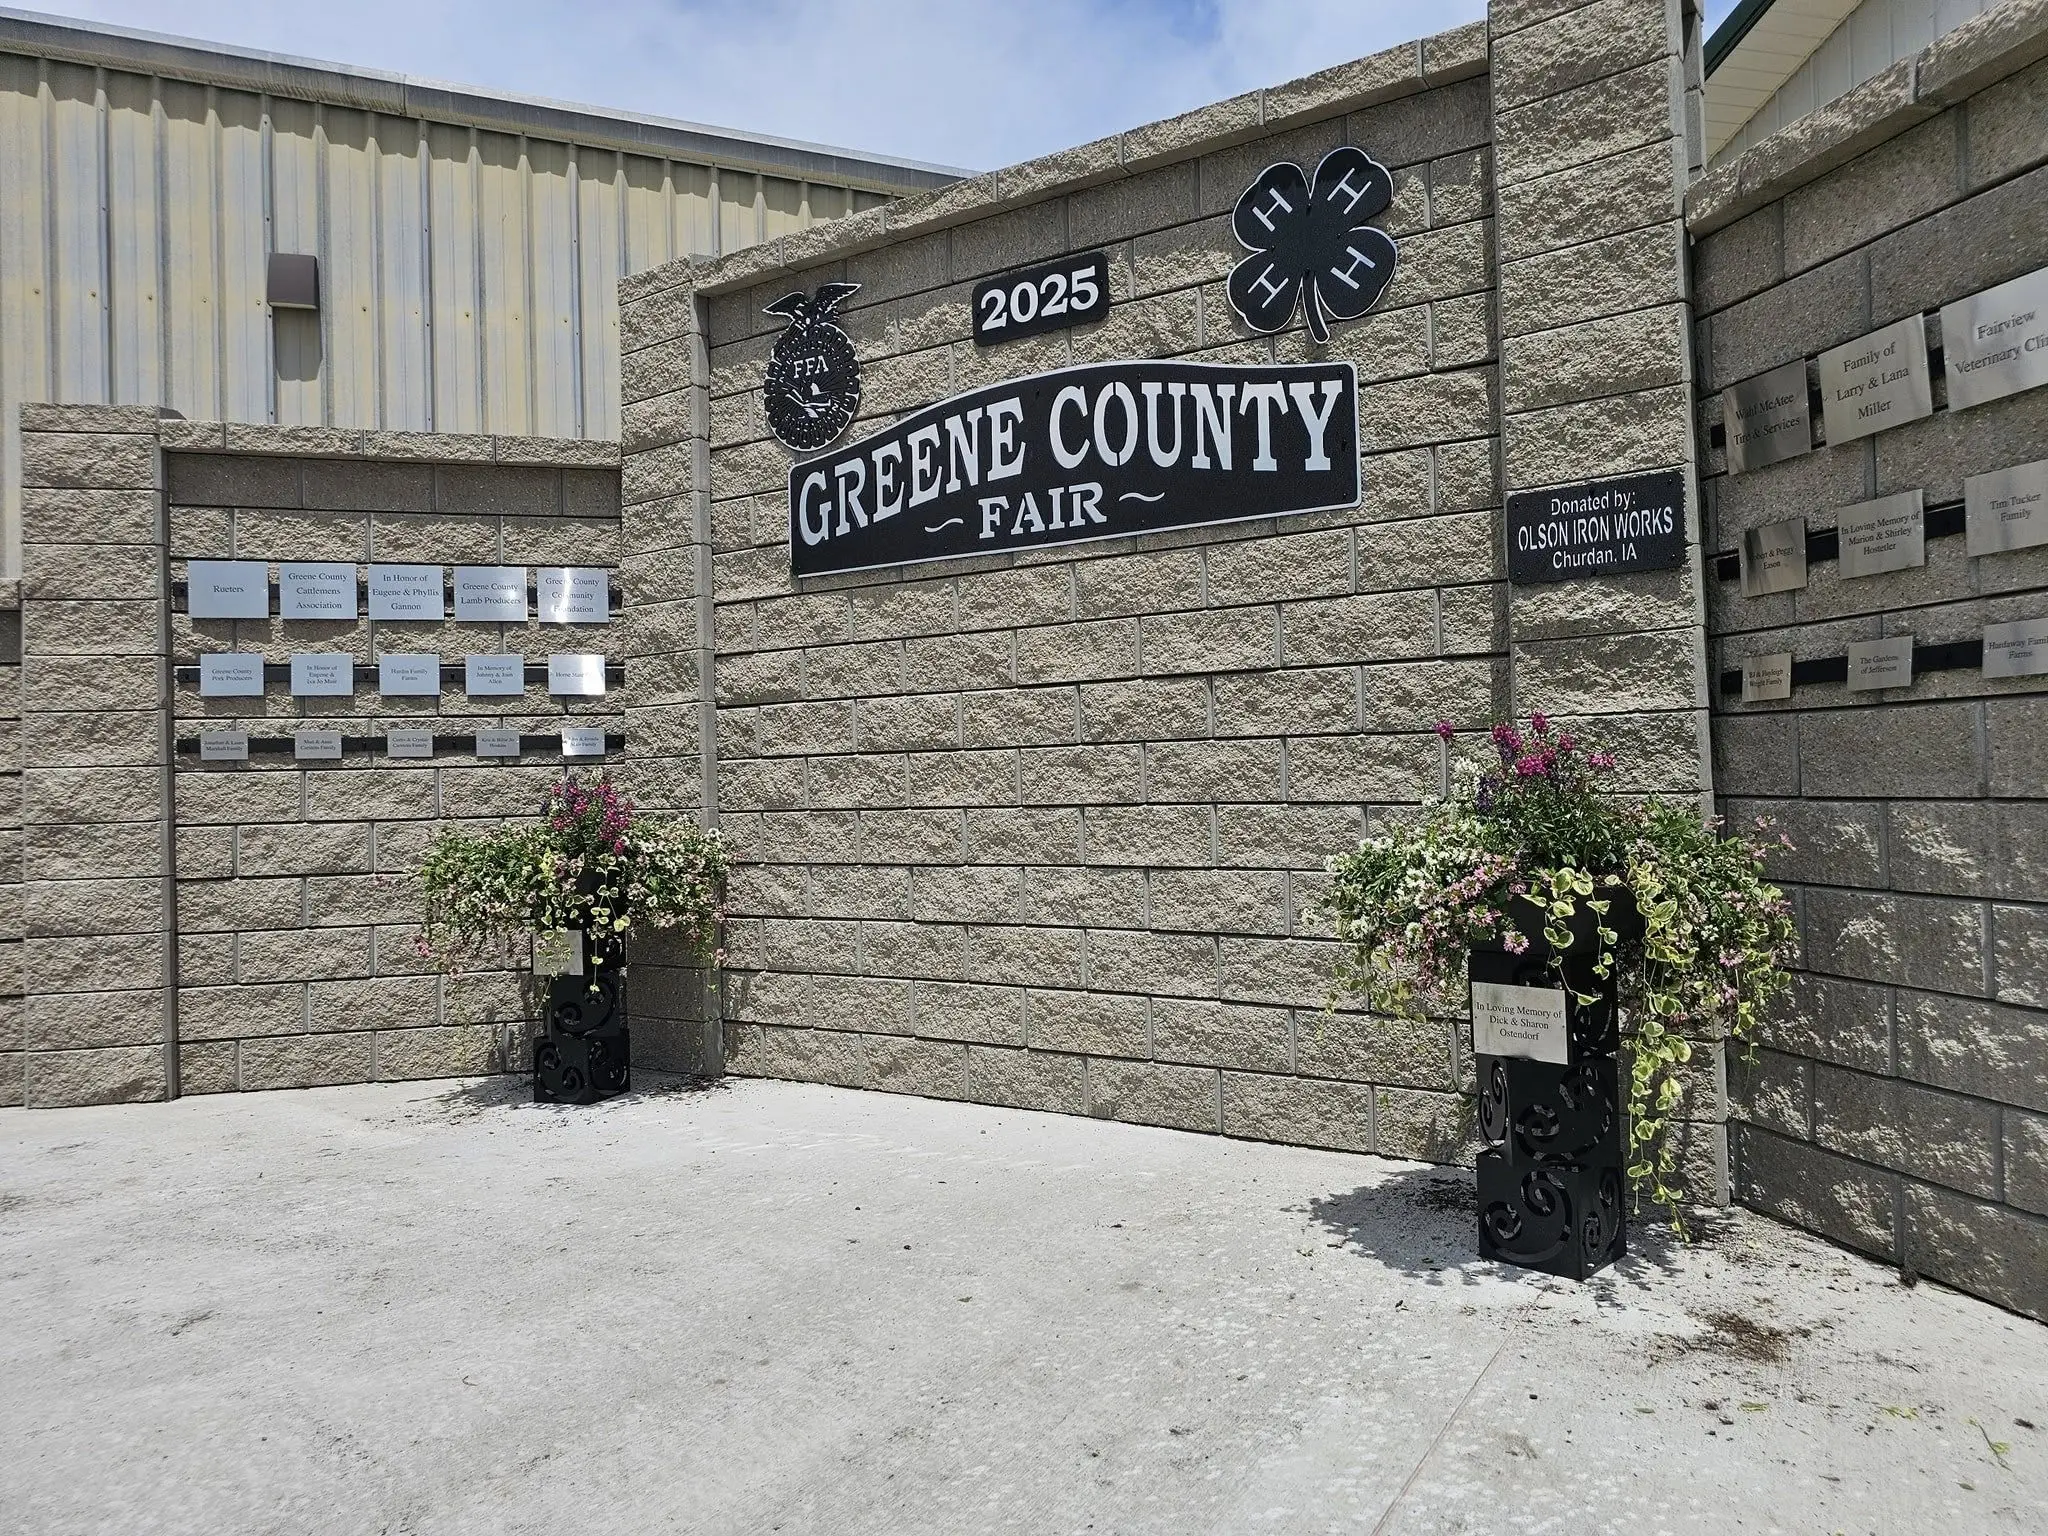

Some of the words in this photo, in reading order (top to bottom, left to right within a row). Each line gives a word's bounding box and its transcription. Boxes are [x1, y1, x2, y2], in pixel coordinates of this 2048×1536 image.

[1327, 167, 1372, 215] H
[1252, 187, 1293, 232] H
[1330, 245, 1376, 290] H
[1247, 262, 1289, 309] H
[980, 265, 1100, 331] 2025
[1977, 311, 2035, 340] Fairview
[1843, 352, 1880, 373] Family
[1883, 341, 1897, 357] of
[1955, 346, 2020, 374] Veterinary
[793, 355, 829, 379] FFA
[1836, 383, 1865, 402] Larry
[1868, 377, 1879, 388] &
[1881, 366, 1909, 384] Lana
[1760, 394, 1794, 413] McAtee
[1857, 400, 1892, 419] Miller
[1734, 433, 1751, 445] Tire
[1752, 429, 1760, 438] &
[1763, 417, 1800, 435] Services
[799, 396, 1026, 547] GREENE
[1048, 379, 1343, 473] COUNTY
[977, 481, 1107, 540] FAIR
[1551, 491, 1609, 516] Donated
[1614, 490, 1636, 511] by:
[1990, 500, 2008, 510] Tim
[2009, 493, 2042, 506] Tucker
[1842, 527, 1849, 535] In
[1850, 521, 1876, 534] Loving
[1877, 516, 1909, 529] Memory
[1911, 511, 1921, 521] of
[2001, 509, 2032, 522] Family
[1518, 520, 1569, 551] OLSON
[1573, 515, 1610, 545] IRON
[1614, 506, 1673, 540] WORKS
[1849, 534, 1874, 546] Marion
[1875, 532, 1883, 540] &
[1884, 527, 1912, 540] Shirley
[1622, 542, 1638, 561] IA
[1769, 549, 1775, 557] &
[1776, 546, 1794, 557] Peggy
[1863, 543, 1896, 555] Hostetler
[1763, 561, 1781, 570] Eason
[288, 573, 316, 581] Greene
[319, 573, 347, 582] County
[420, 574, 429, 582] of
[573, 578, 600, 587] County
[213, 585, 244, 593] Rueters
[296, 587, 341, 595] Cattlemens
[372, 588, 402, 597] Eugene
[413, 588, 440, 597] Phyllis
[491, 583, 518, 592] County
[552, 592, 594, 600] Comunity
[1873, 655, 1898, 663] Gardens
[1869, 665, 1897, 673] Jefferson
[1476, 1002, 1485, 1011] In
[1487, 1003, 1515, 1015] Loving
[1516, 1006, 1551, 1019] Memory
[1553, 1010, 1562, 1019] of
[1489, 1015, 1509, 1025] Dick
[1511, 1018, 1519, 1026] &
[1520, 1018, 1549, 1029] Sharon
[1500, 1028, 1540, 1040] Ostendorf
